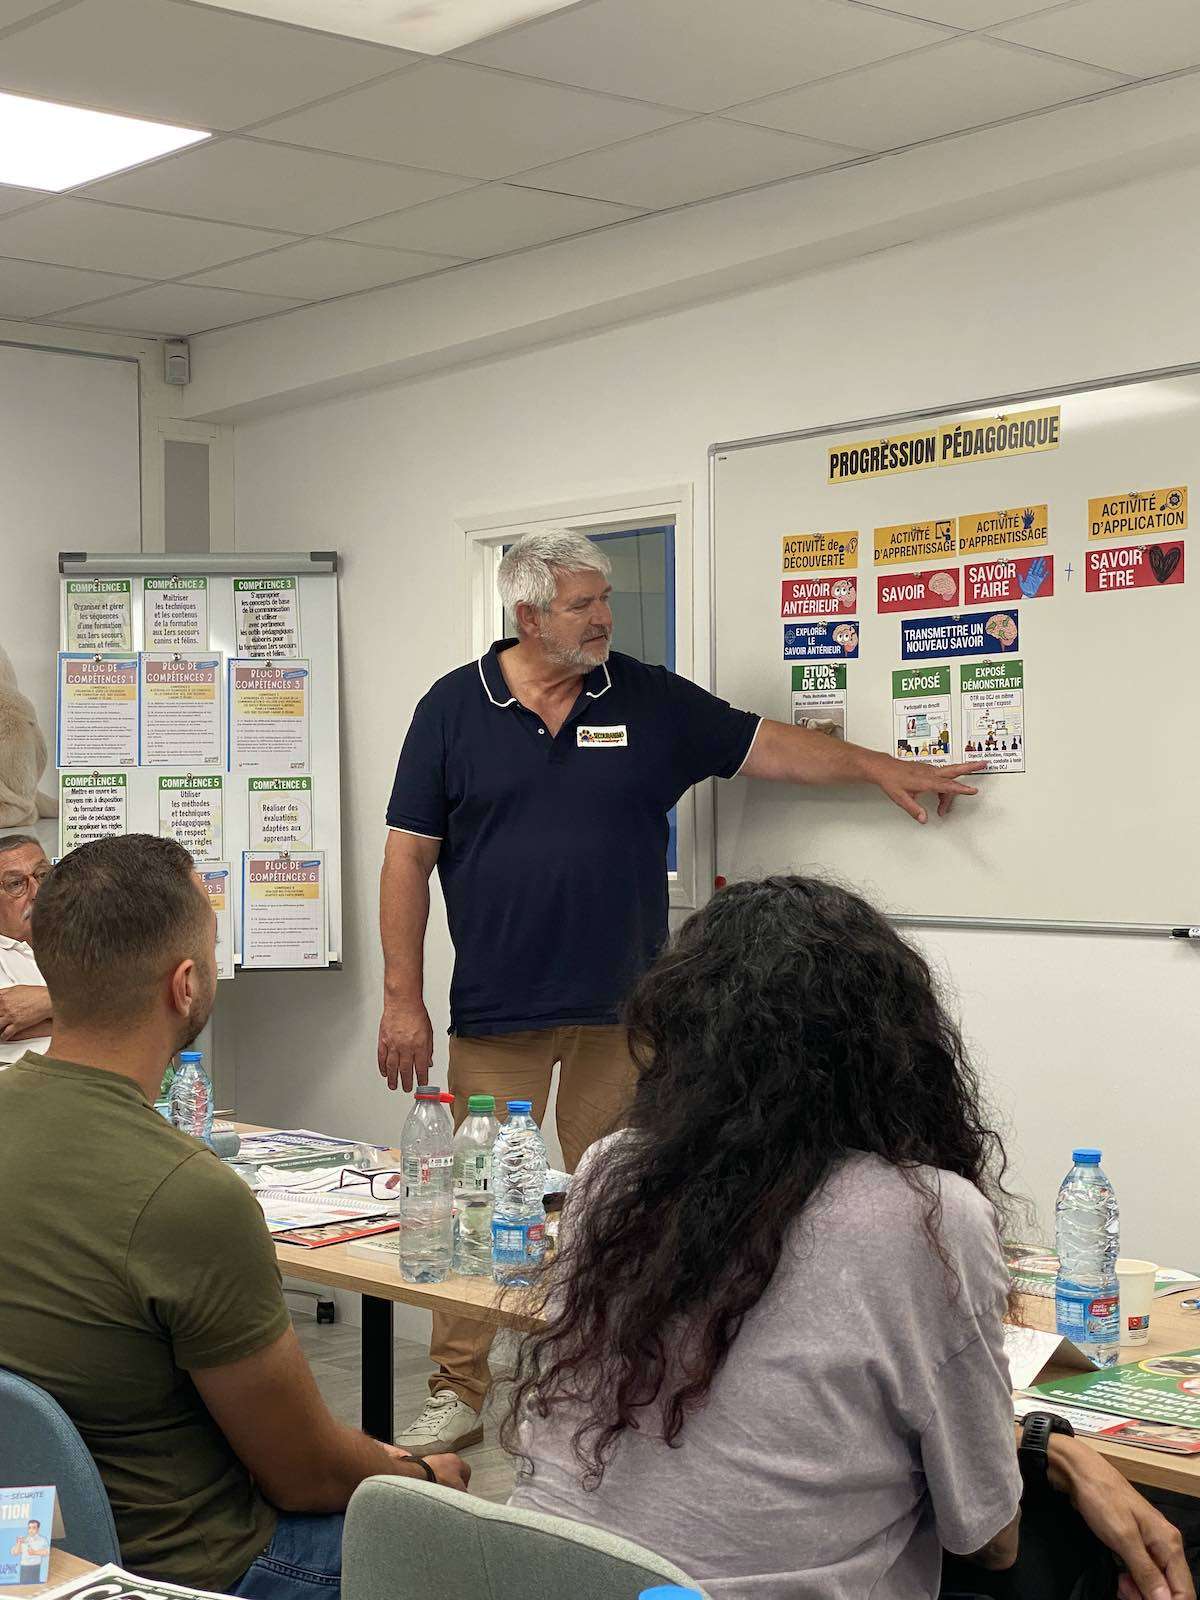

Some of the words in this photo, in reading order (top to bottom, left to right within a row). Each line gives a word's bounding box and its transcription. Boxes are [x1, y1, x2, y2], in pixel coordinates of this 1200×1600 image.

[830, 437, 936, 478] PROGRESSION
[943, 416, 1058, 460] PÉDAGOGIQUE
[1102, 494, 1156, 516] ACTIVITÉ
[977, 514, 1019, 533] ACTIVITÉ
[1093, 511, 1184, 535] D'APPLICATION
[891, 528, 929, 544] ACTIVITÉ
[960, 528, 1047, 549] D'APPRENTISSAGE
[785, 537, 825, 553] ACTIVITÉ
[828, 539, 838, 550] de
[874, 540, 956, 560] D'APPRENTISSAGE
[784, 554, 844, 568] DÉCOUVERTE
[1091, 549, 1142, 569] SAVOIR
[969, 563, 1016, 583] SAVOIR
[1099, 569, 1134, 588] ÊTRE
[123, 583, 127, 591] 1
[199, 580, 204, 588] 2
[239, 580, 284, 589] COMPÉTENCE
[287, 580, 291, 588] 3
[793, 584, 830, 598] SAVOIR
[974, 581, 1009, 599] FAIRE
[882, 584, 924, 602] SAVOIR
[783, 596, 839, 614] ANTÉRIEUR
[796, 628, 827, 636] EXPLORER
[904, 625, 968, 641] TRANSMETTRE
[971, 623, 983, 634] UN
[785, 647, 806, 655] SAVOIR
[808, 644, 841, 654] ANTÉRIEUR
[907, 638, 948, 652] NOUVEAU
[950, 636, 983, 648] SAVOIR
[82, 664, 106, 672] BLOC
[108, 663, 117, 671] DE
[163, 662, 185, 670] BLOC
[976, 665, 1005, 677] EXPOSÉ
[68, 673, 126, 683] COMPÉTENCES
[130, 675, 134, 683] 1
[147, 671, 204, 682] COMPÉTENCES
[236, 679, 291, 688] COMPÉTENCES
[802, 679, 814, 690] DE
[817, 677, 836, 689] CAS
[902, 672, 940, 690] EXPOSÉ
[963, 677, 1021, 690] DÉMONSTRATIF
[302, 780, 307, 788] 6
[265, 862, 287, 870] BLOC
[290, 862, 299, 870] DE
[251, 871, 306, 881] COMPÉTENCES
